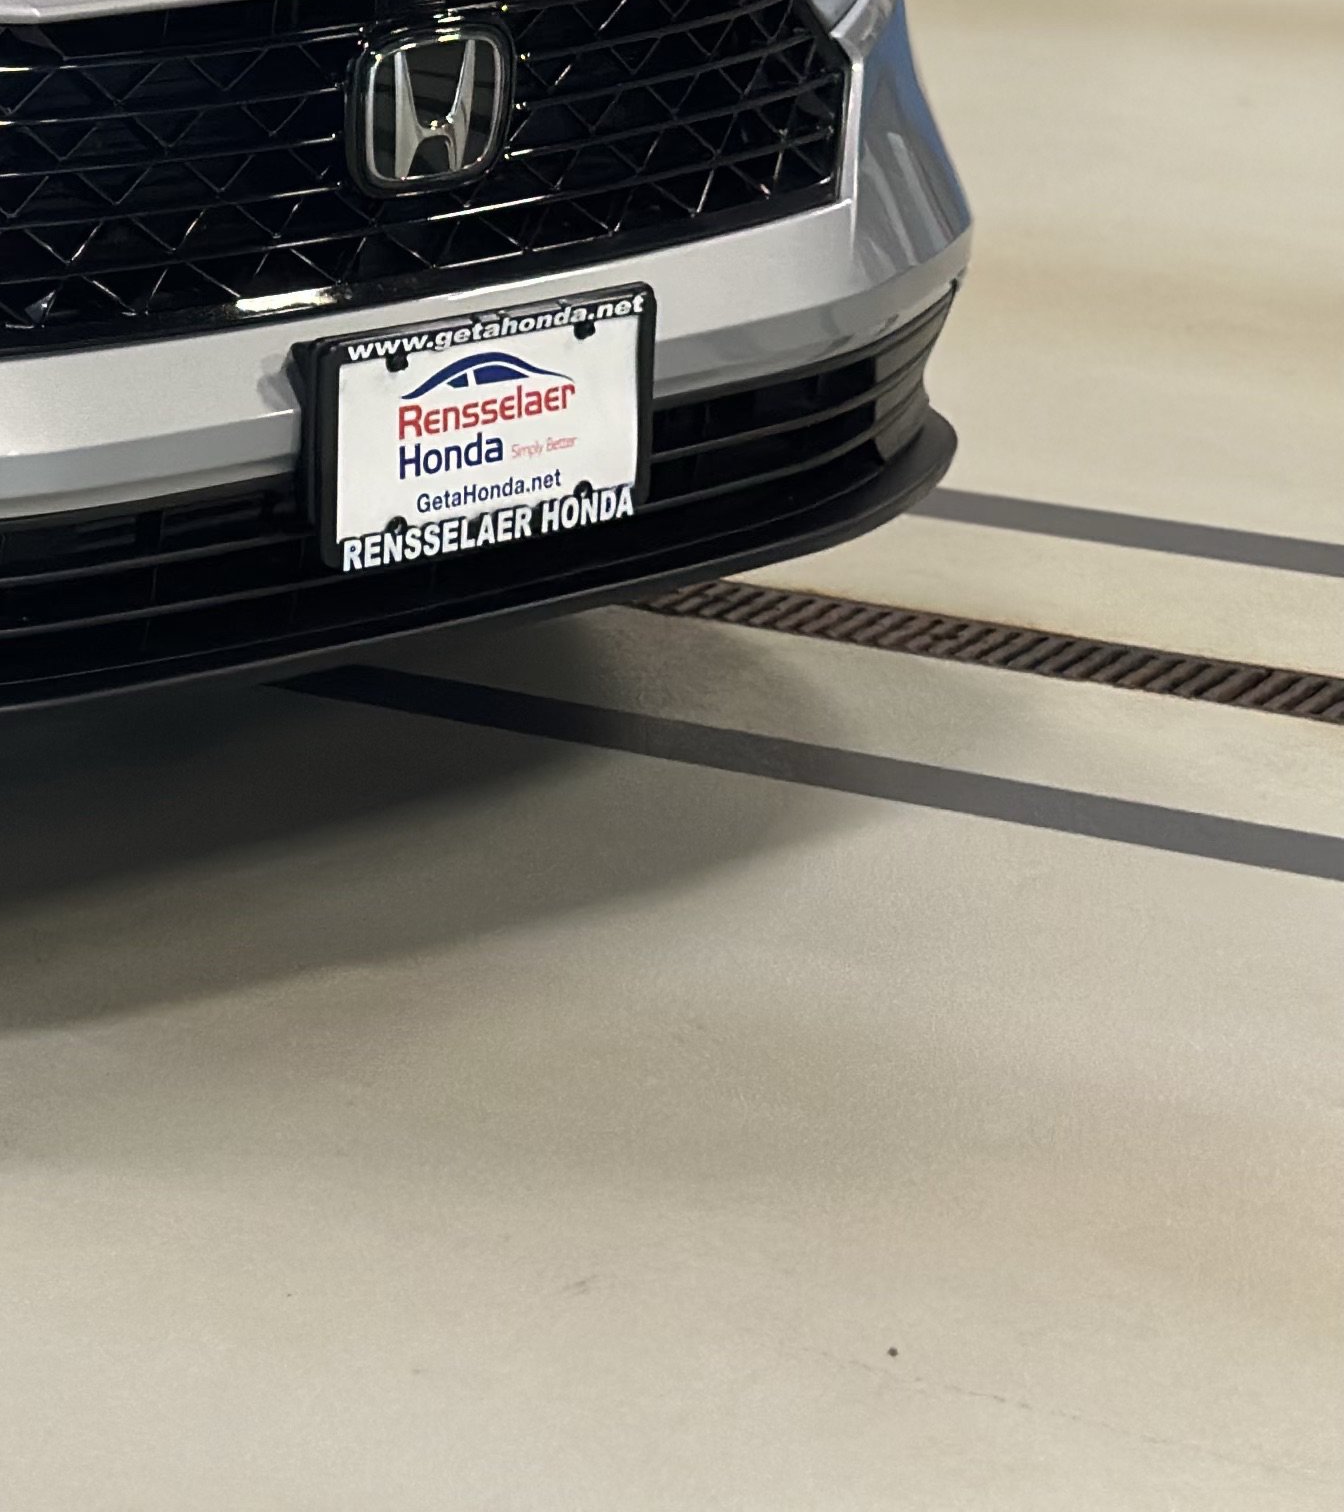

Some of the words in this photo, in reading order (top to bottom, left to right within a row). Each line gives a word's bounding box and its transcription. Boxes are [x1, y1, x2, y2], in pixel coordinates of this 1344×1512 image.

[347, 294, 645, 362] www.getahonda.net
[398, 383, 576, 440] Rensselaer
[398, 432, 504, 480] Honda
[416, 468, 562, 514] GetaHonda.net
[342, 504, 533, 572] RENSSELAER
[540, 486, 635, 535] HONDA
